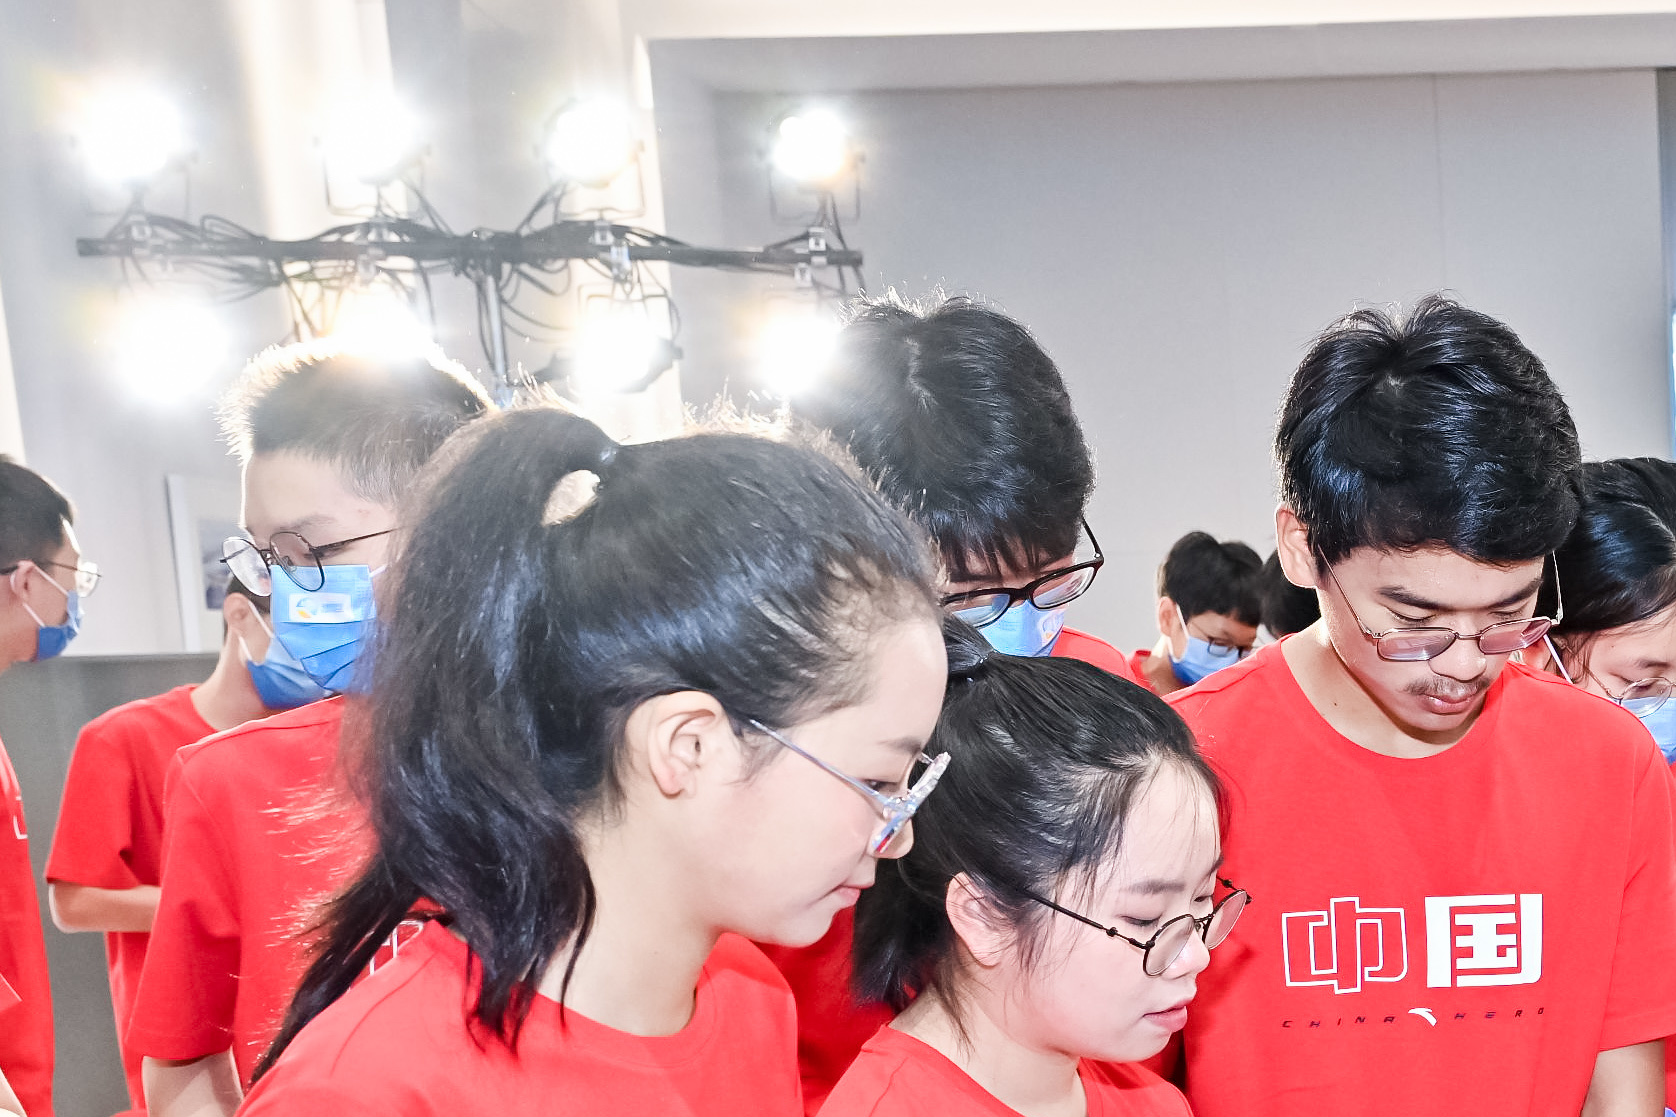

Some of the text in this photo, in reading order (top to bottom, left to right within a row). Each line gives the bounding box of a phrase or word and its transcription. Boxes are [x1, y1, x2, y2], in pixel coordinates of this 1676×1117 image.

[1281, 893, 1543, 995] 中国
[1282, 1006, 1545, 1029] CHINA HERO
